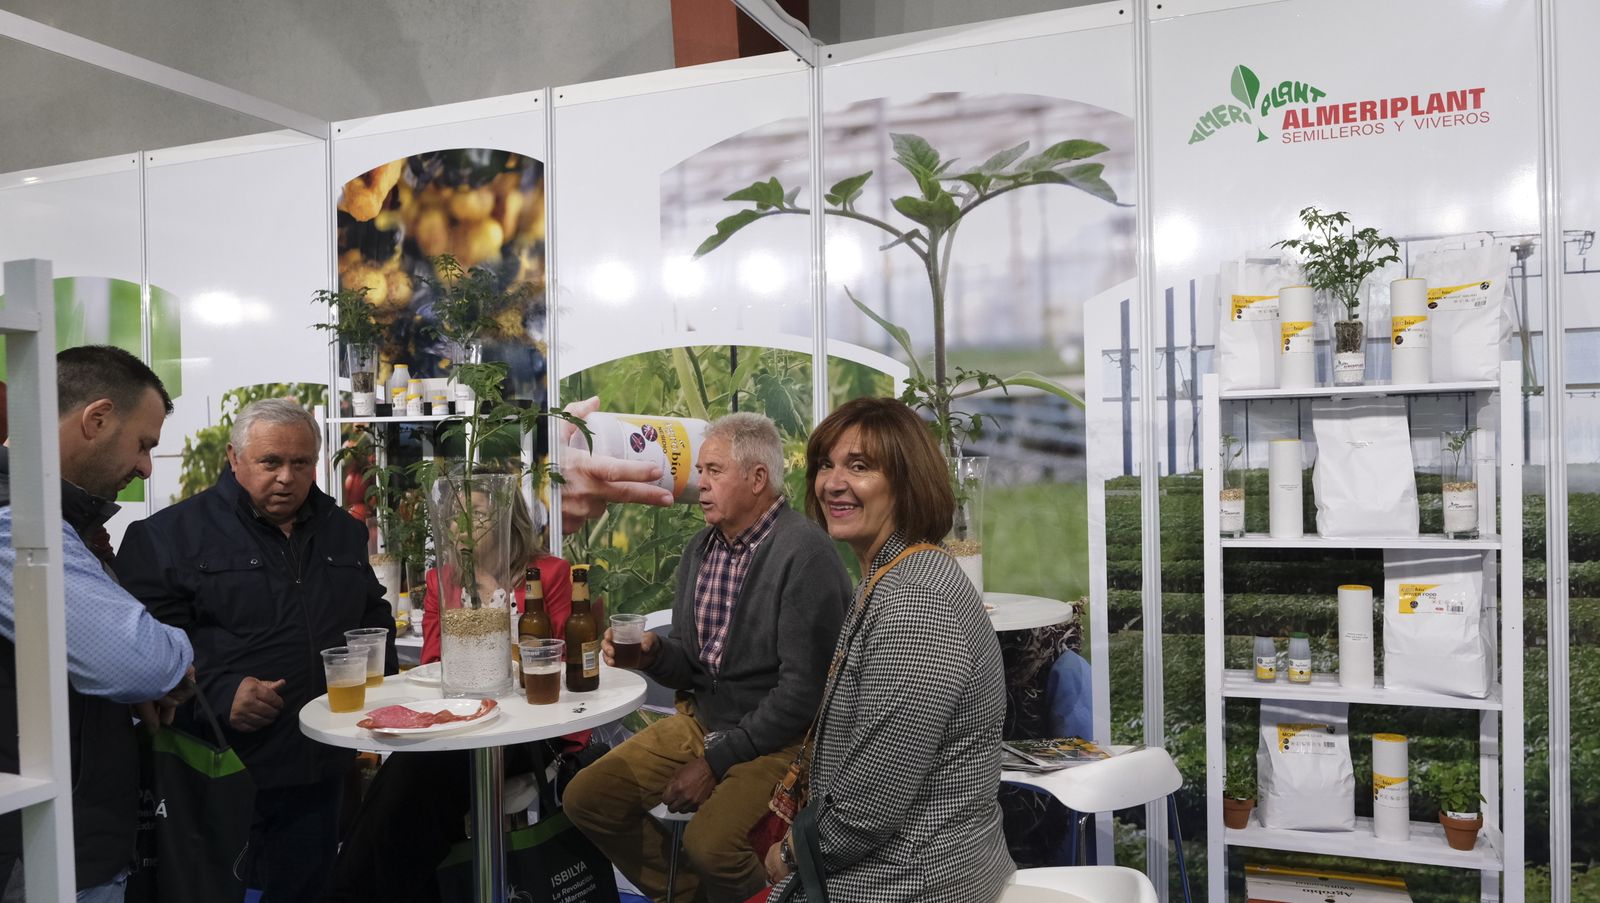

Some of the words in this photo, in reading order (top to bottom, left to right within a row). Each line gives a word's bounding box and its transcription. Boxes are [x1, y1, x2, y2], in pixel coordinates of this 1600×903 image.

[1282, 87, 1486, 130] ALMERIPLANT
[1282, 122, 1385, 144] SEMILLEROS
[1394, 120, 1405, 133] Y
[1414, 111, 1491, 131] VIVEROS
[551, 861, 587, 887] ISBILYA
